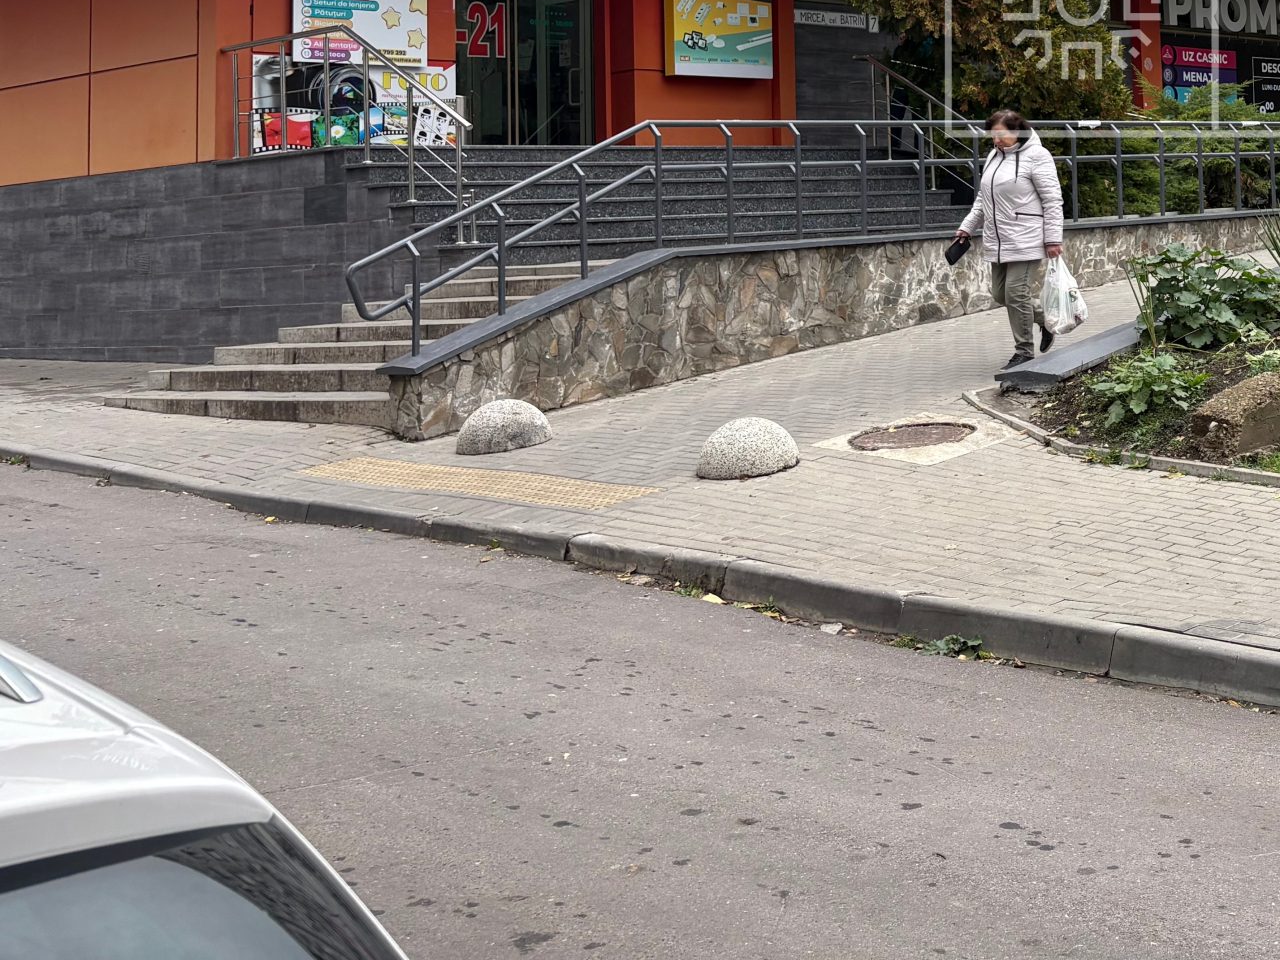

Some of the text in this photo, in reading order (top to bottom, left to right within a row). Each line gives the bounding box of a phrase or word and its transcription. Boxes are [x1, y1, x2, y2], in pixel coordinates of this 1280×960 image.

[800, 12, 826, 23] MIRCEA
[870, 17, 877, 30] 7
[1182, 50, 1228, 64] UZ CASNIC
[382, 71, 448, 91] FOTO
